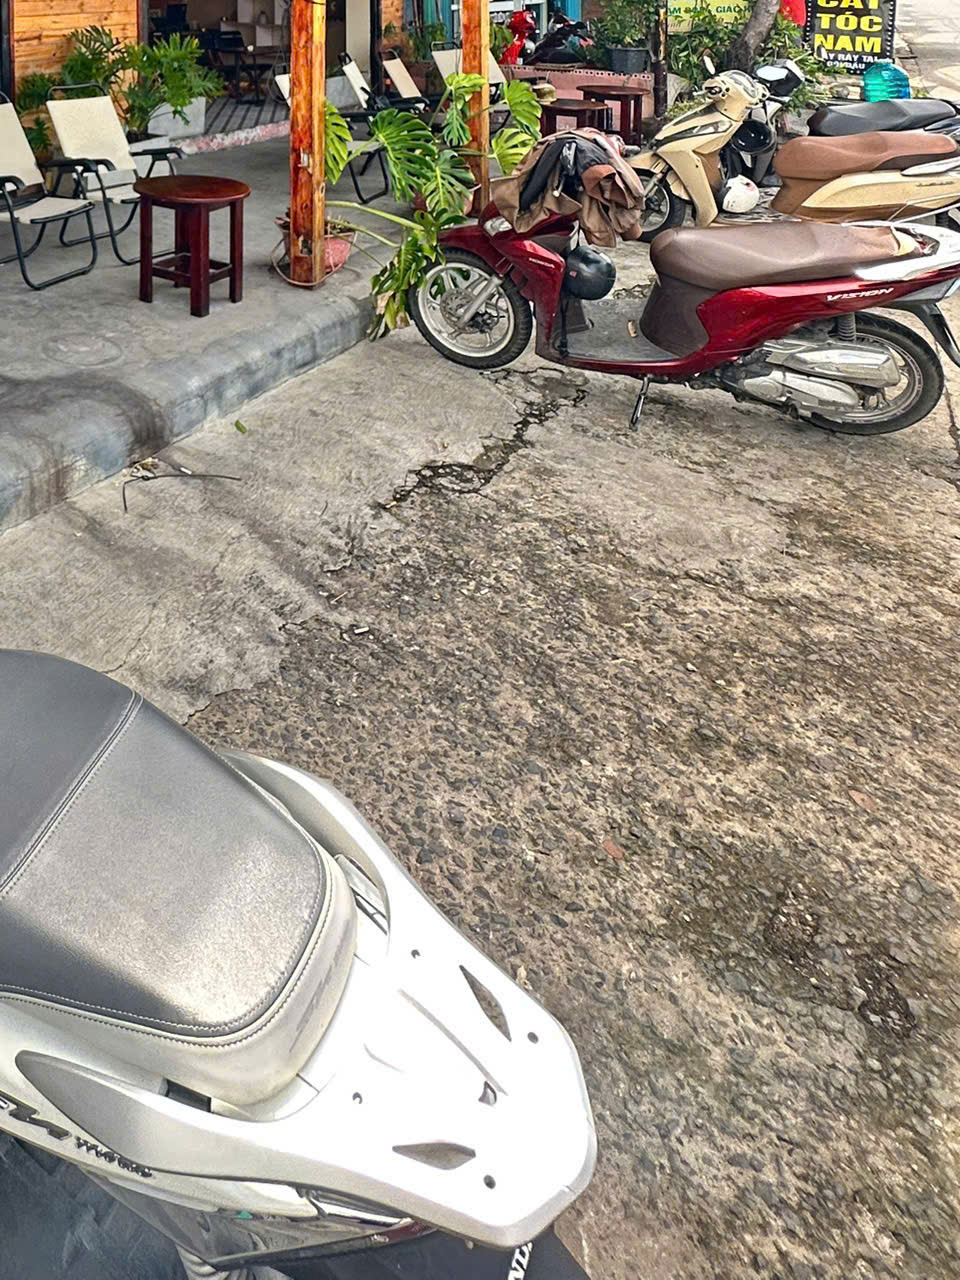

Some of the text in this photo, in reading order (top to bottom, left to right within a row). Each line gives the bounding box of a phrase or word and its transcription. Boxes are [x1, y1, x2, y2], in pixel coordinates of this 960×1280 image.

[816, 11, 883, 32] TÓC
[814, 33, 882, 53] NAM
[826, 287, 895, 301] VISION
